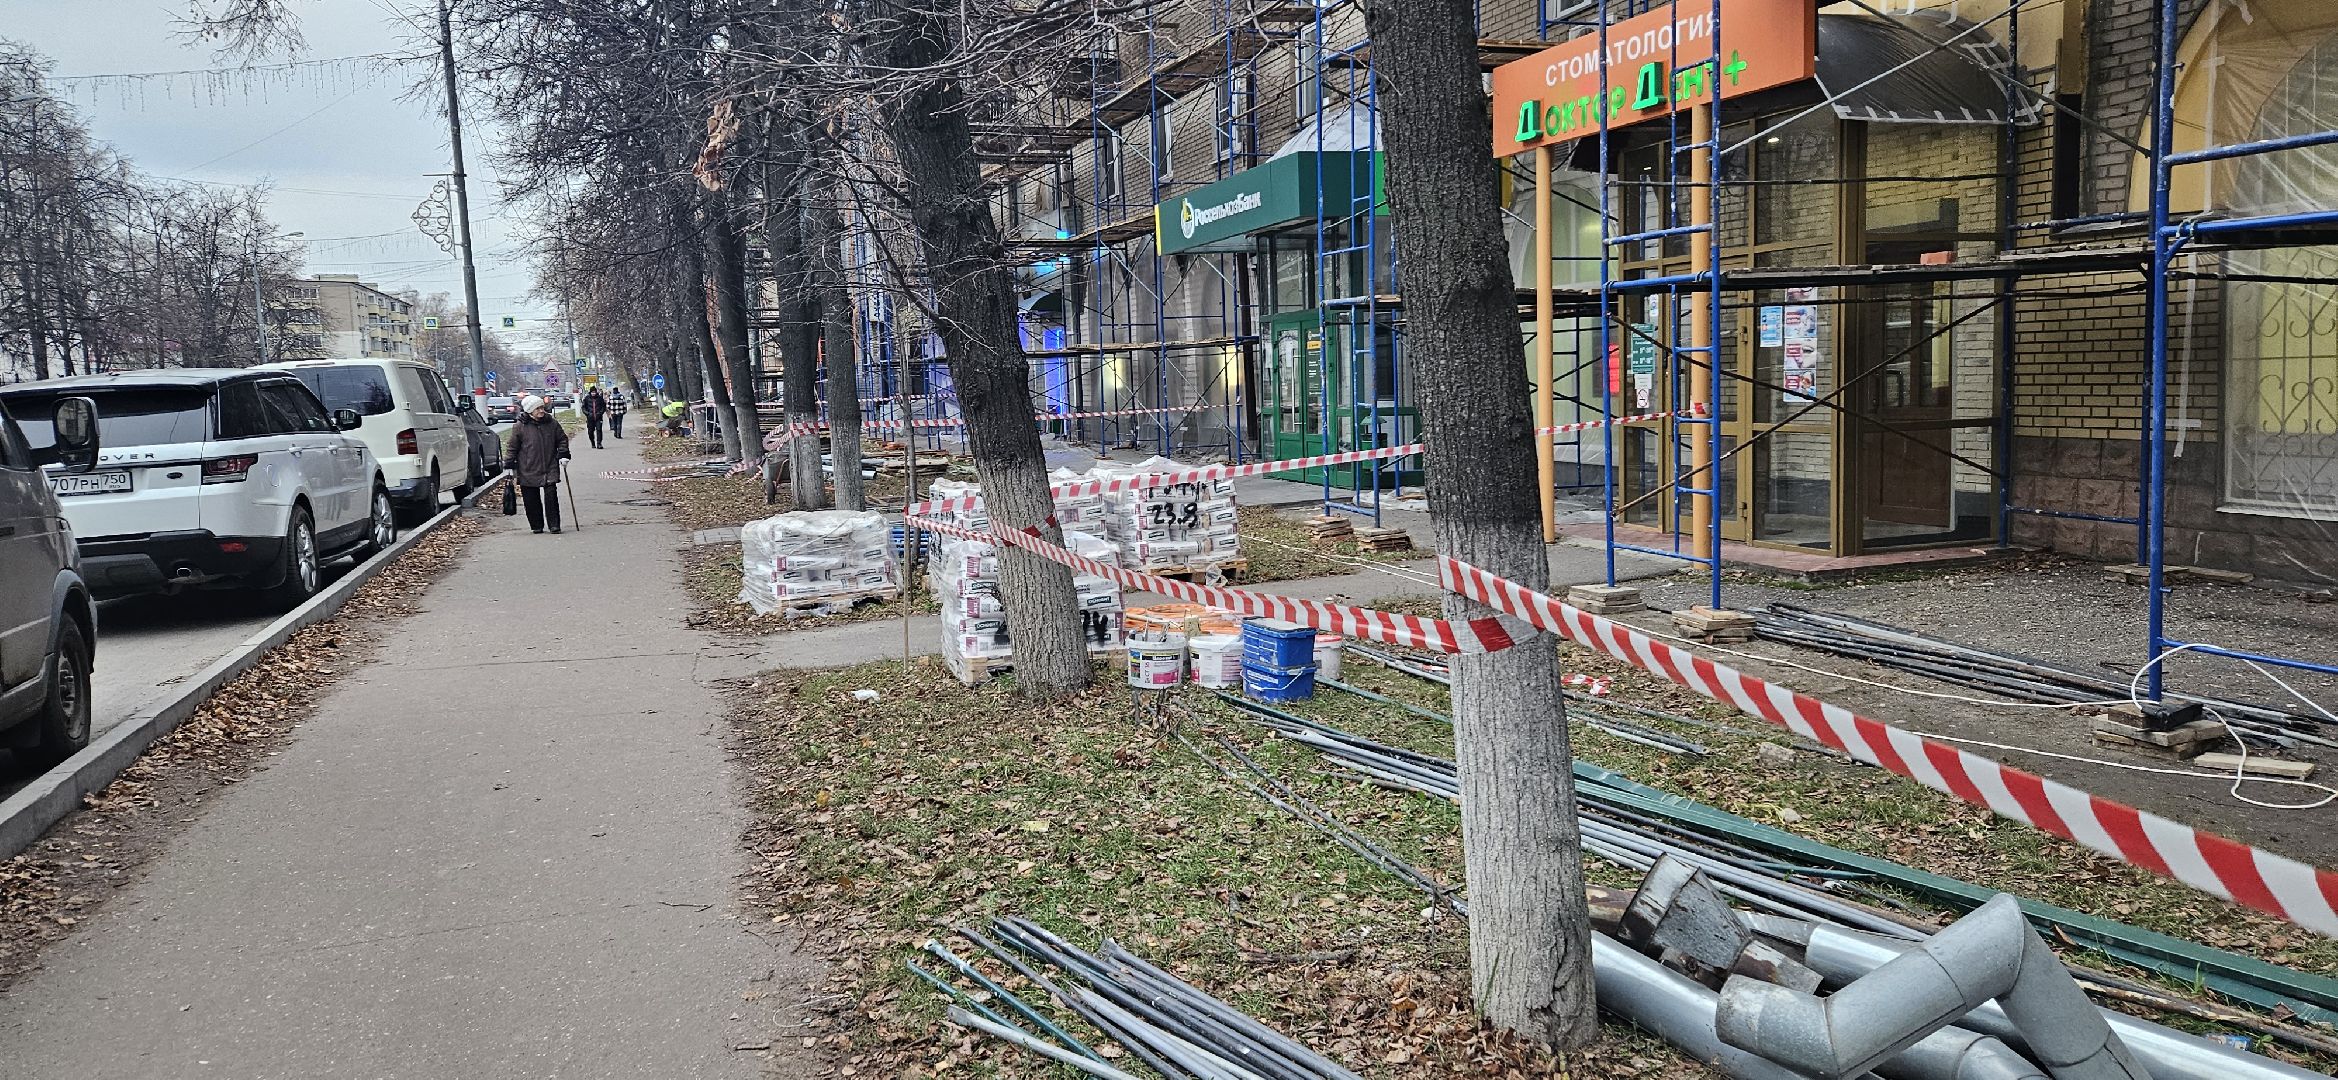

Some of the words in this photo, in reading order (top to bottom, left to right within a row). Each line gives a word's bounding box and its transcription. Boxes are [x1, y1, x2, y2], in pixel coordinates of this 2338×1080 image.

[1545, 10, 1716, 87] СТОМАТОЛОГИЯ
[99, 453, 155, 461] OVER
[49, 477, 99, 491] 707РН
[103, 474, 126, 485] 750
